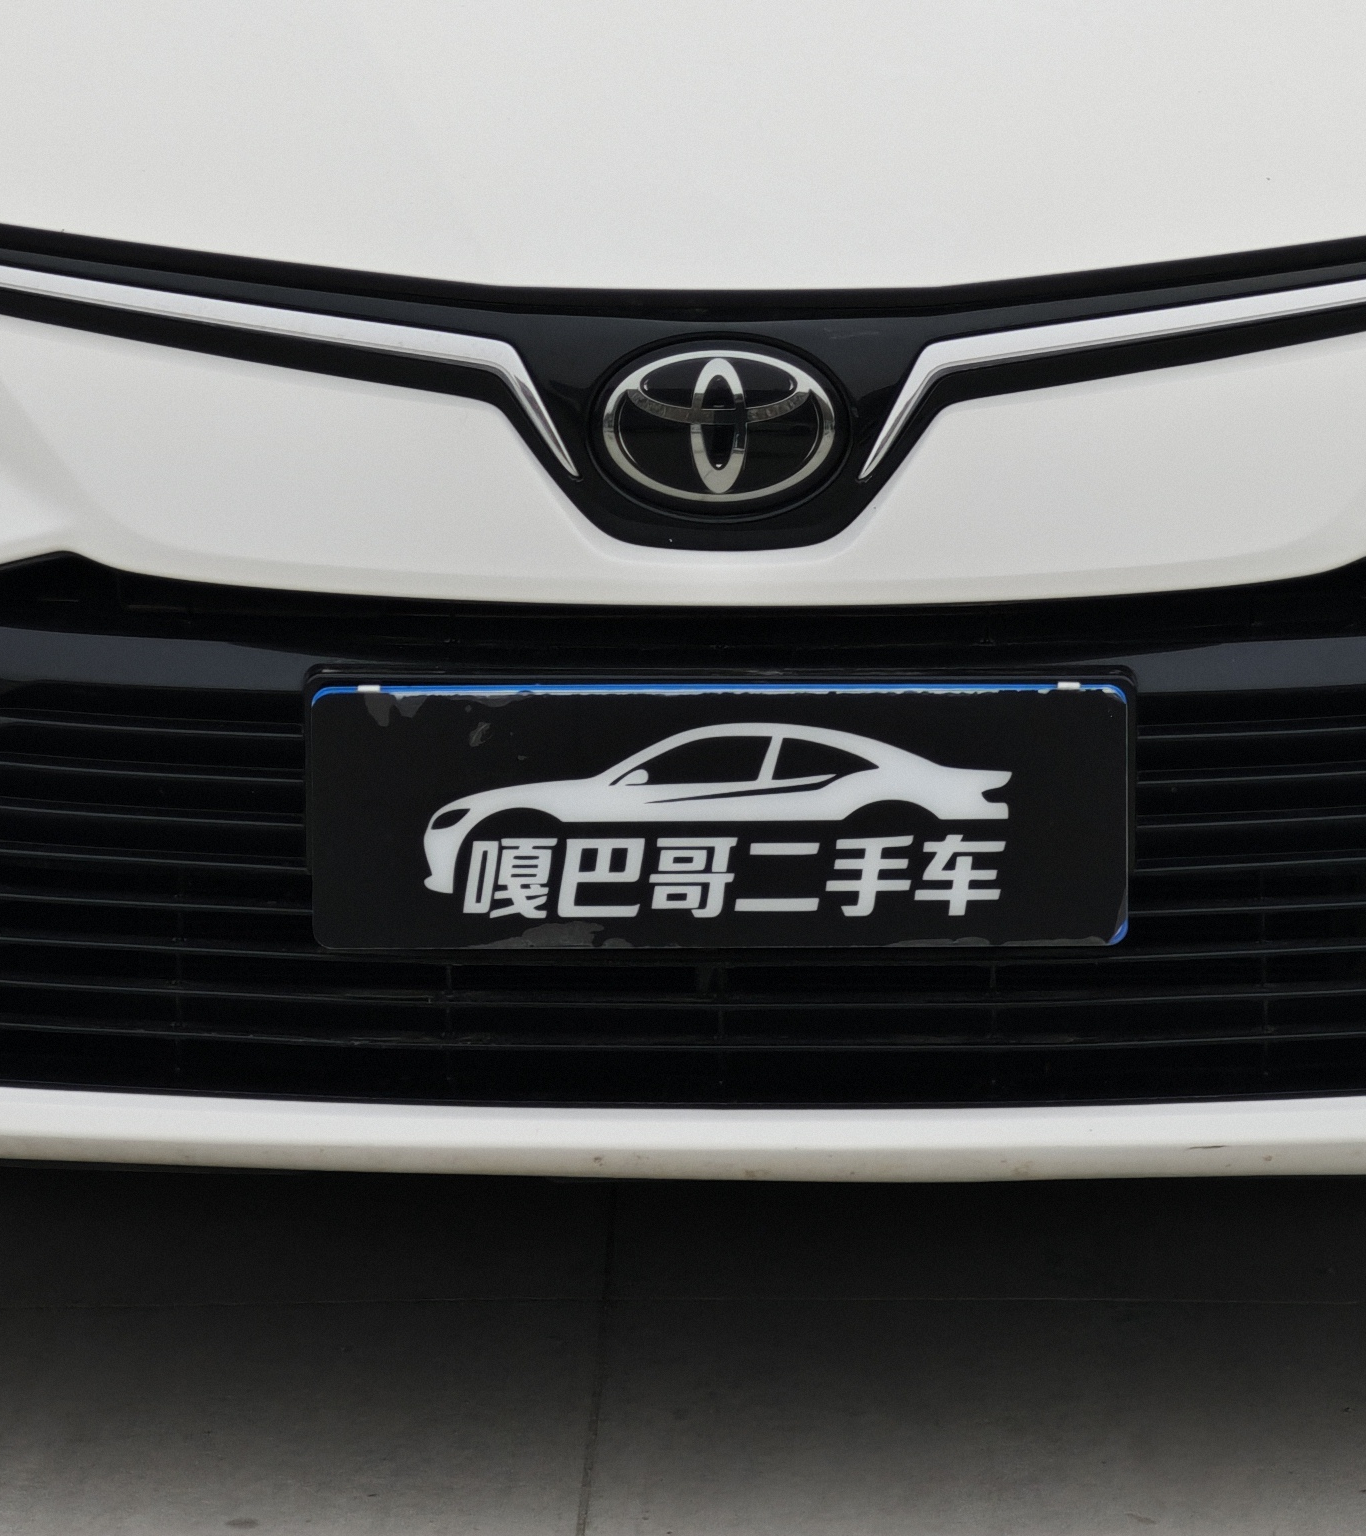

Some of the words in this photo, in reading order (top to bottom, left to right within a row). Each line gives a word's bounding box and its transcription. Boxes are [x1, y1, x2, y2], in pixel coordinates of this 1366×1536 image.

[463, 834, 1006, 918] 嘎巴哥二手车
